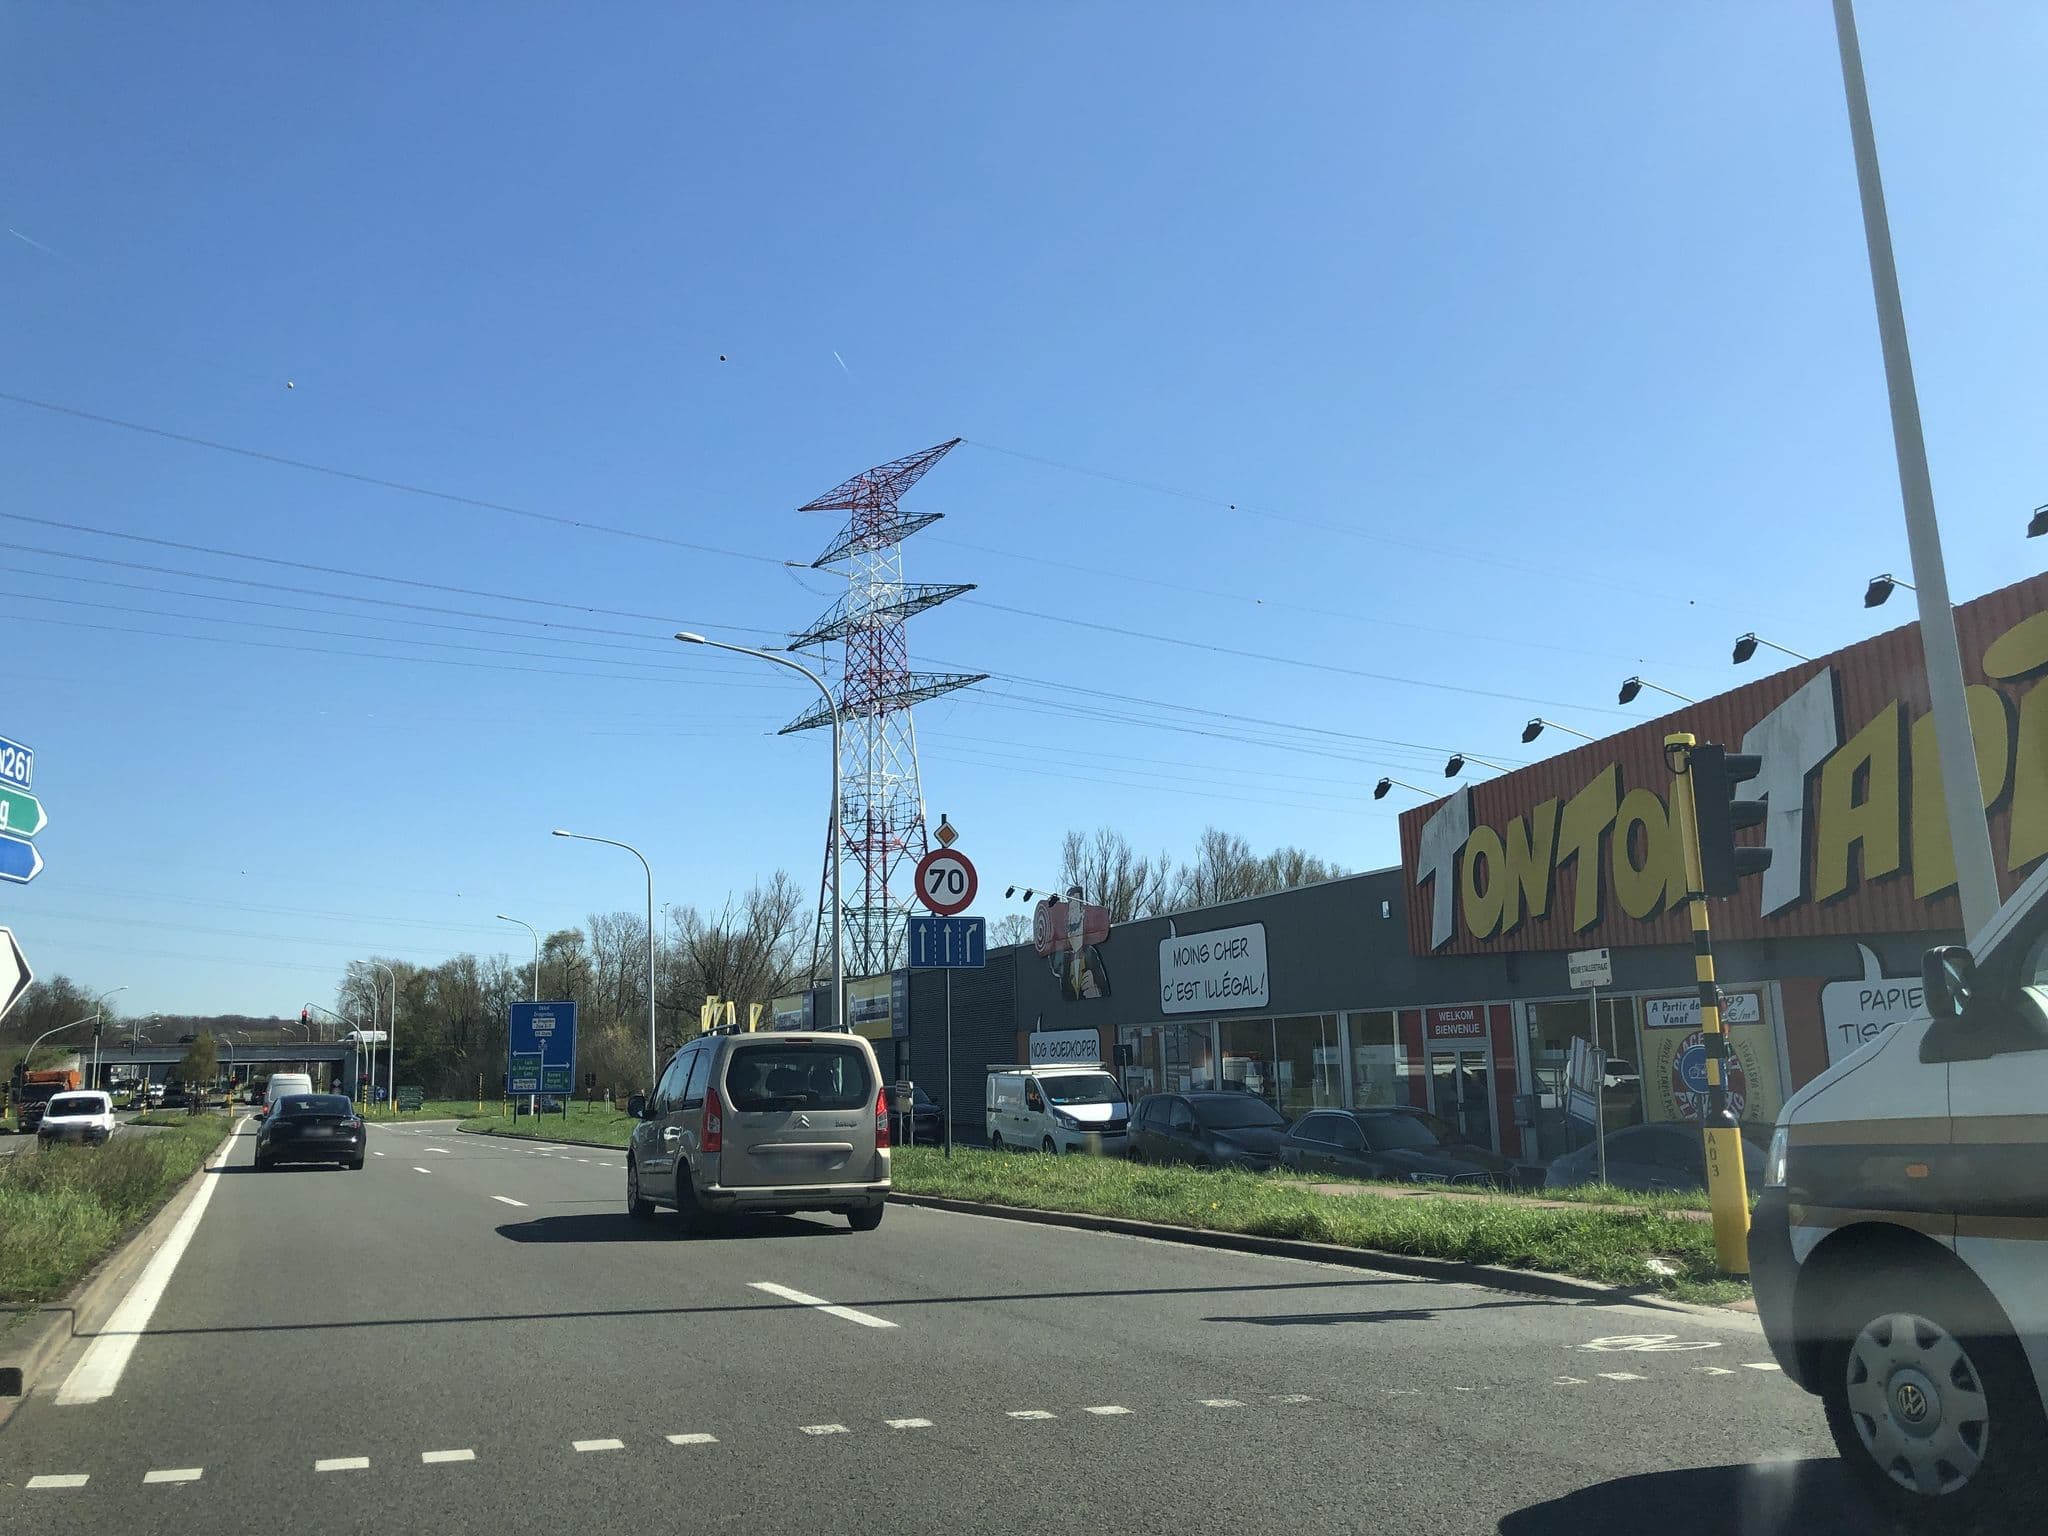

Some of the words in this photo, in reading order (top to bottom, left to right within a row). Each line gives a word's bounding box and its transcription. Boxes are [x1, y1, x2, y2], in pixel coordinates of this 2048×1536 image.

[929, 868, 964, 895] 70
[1173, 944, 1210, 968] MOINS
[1213, 937, 1249, 960] CHER
[1163, 977, 1201, 1002] C'EST
[1662, 1001, 1687, 1011] Partir
[1438, 1009, 1474, 1022] WELKOM
[1663, 1012, 1689, 1024] Vanaf
[1435, 1023, 1481, 1035] BIENVENUE
[1031, 1041, 1047, 1058] NOG
[1049, 1039, 1098, 1058] GOEDKOPER
